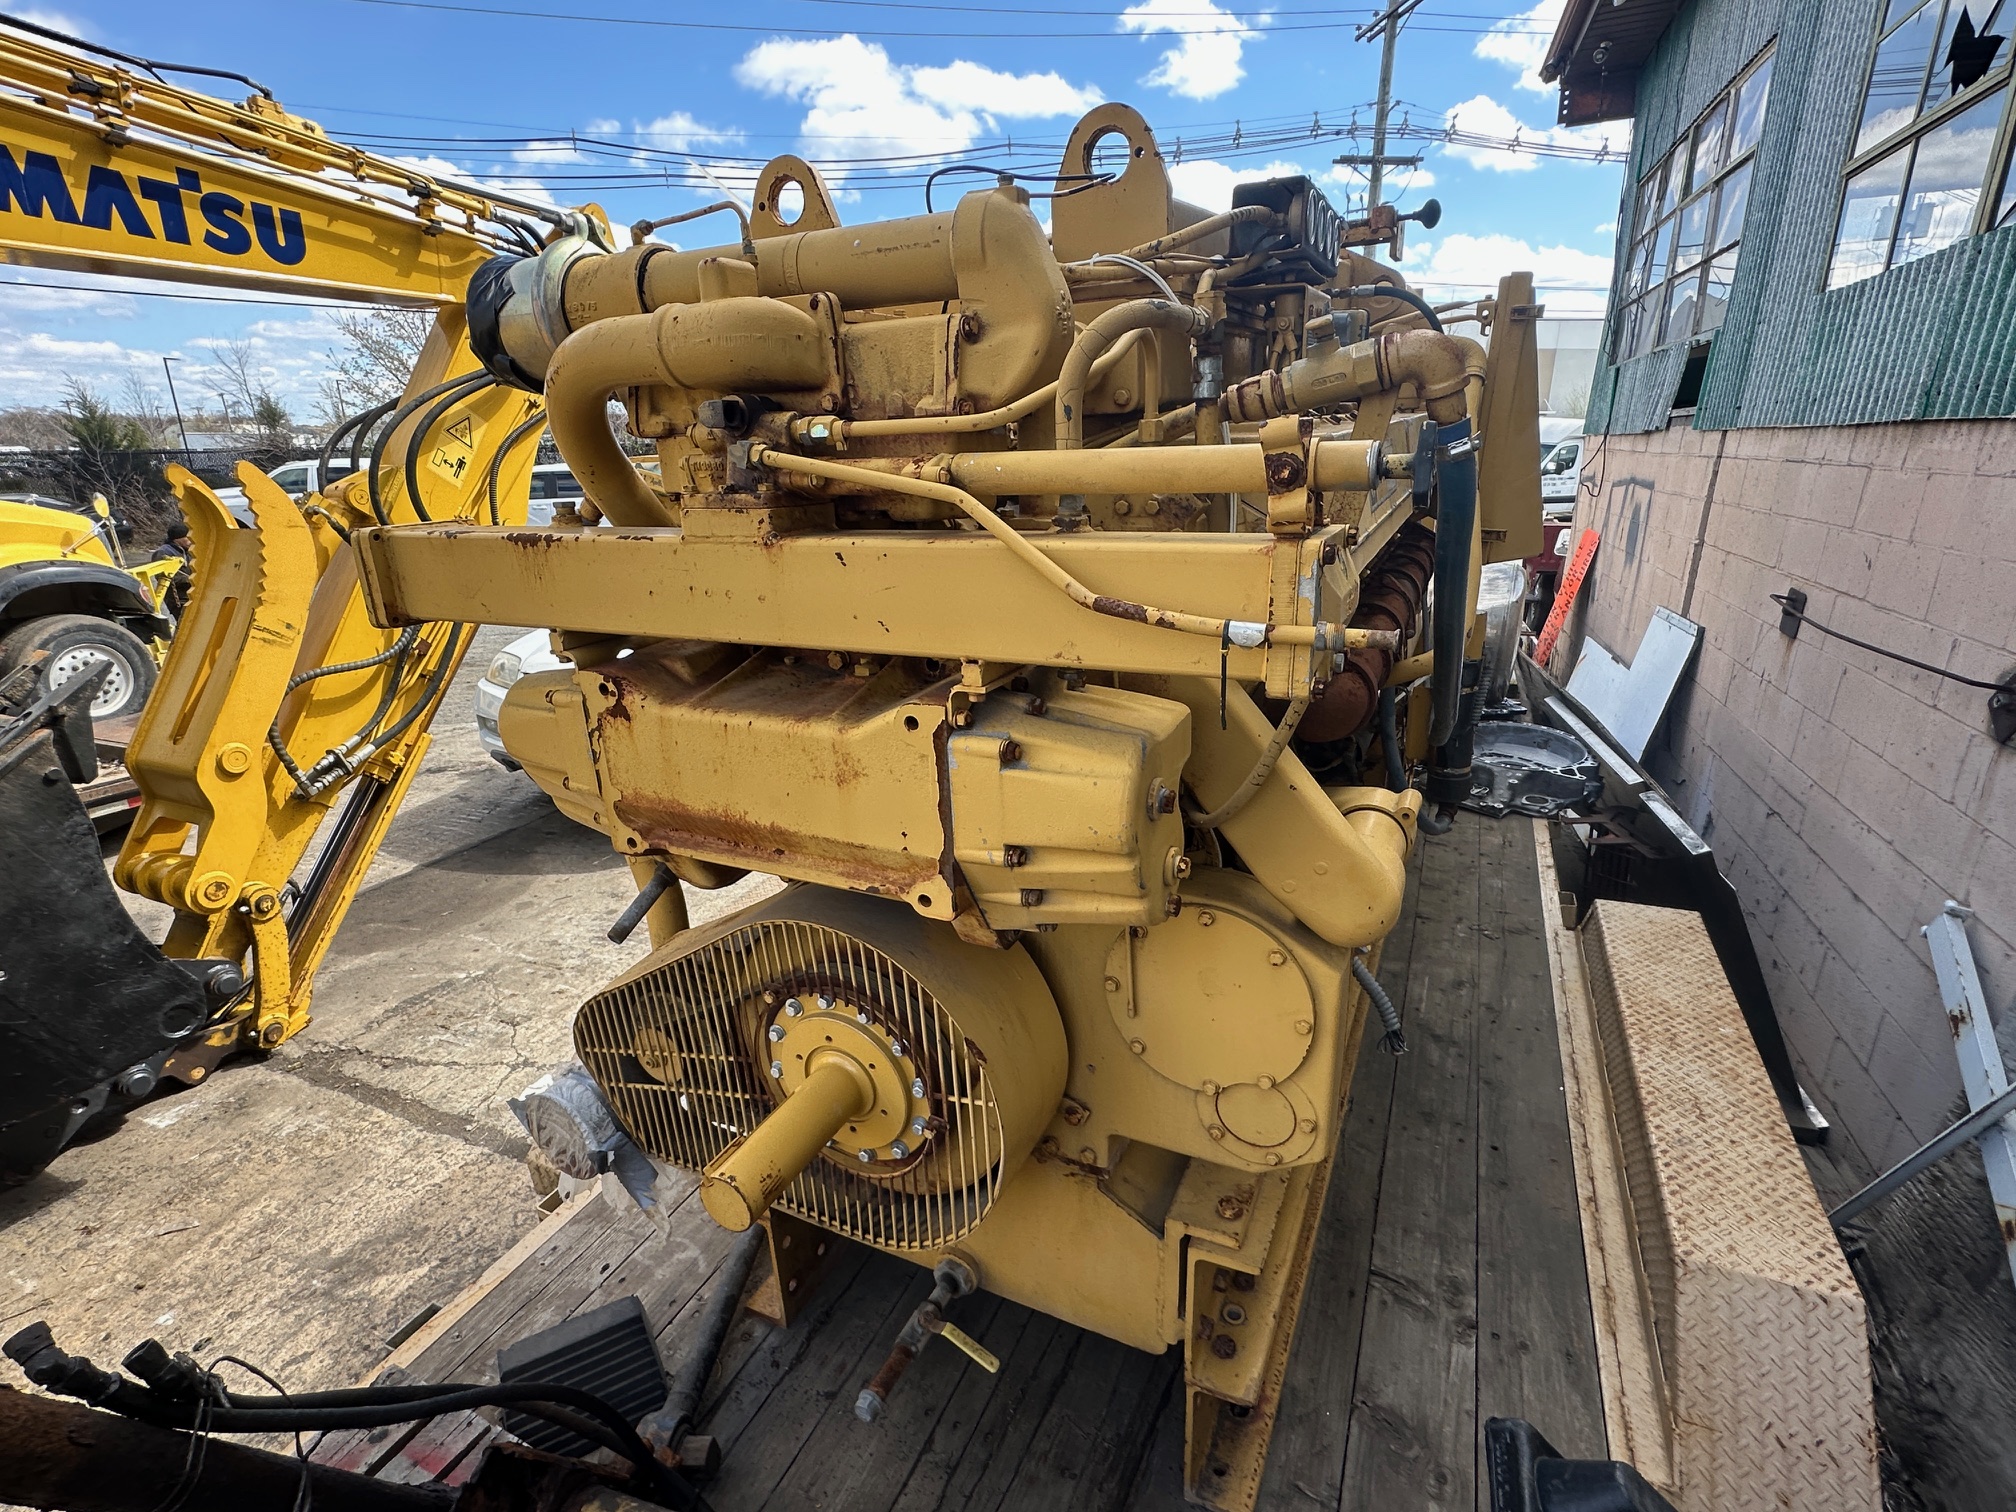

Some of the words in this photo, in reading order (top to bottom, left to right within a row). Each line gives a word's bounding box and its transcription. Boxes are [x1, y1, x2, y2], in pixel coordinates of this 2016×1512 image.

[1559, 543, 1585, 596] VEHICLE
[1561, 590, 1575, 619] AND
[1576, 540, 1597, 582] TURNS
[1564, 569, 1579, 596] FOR
